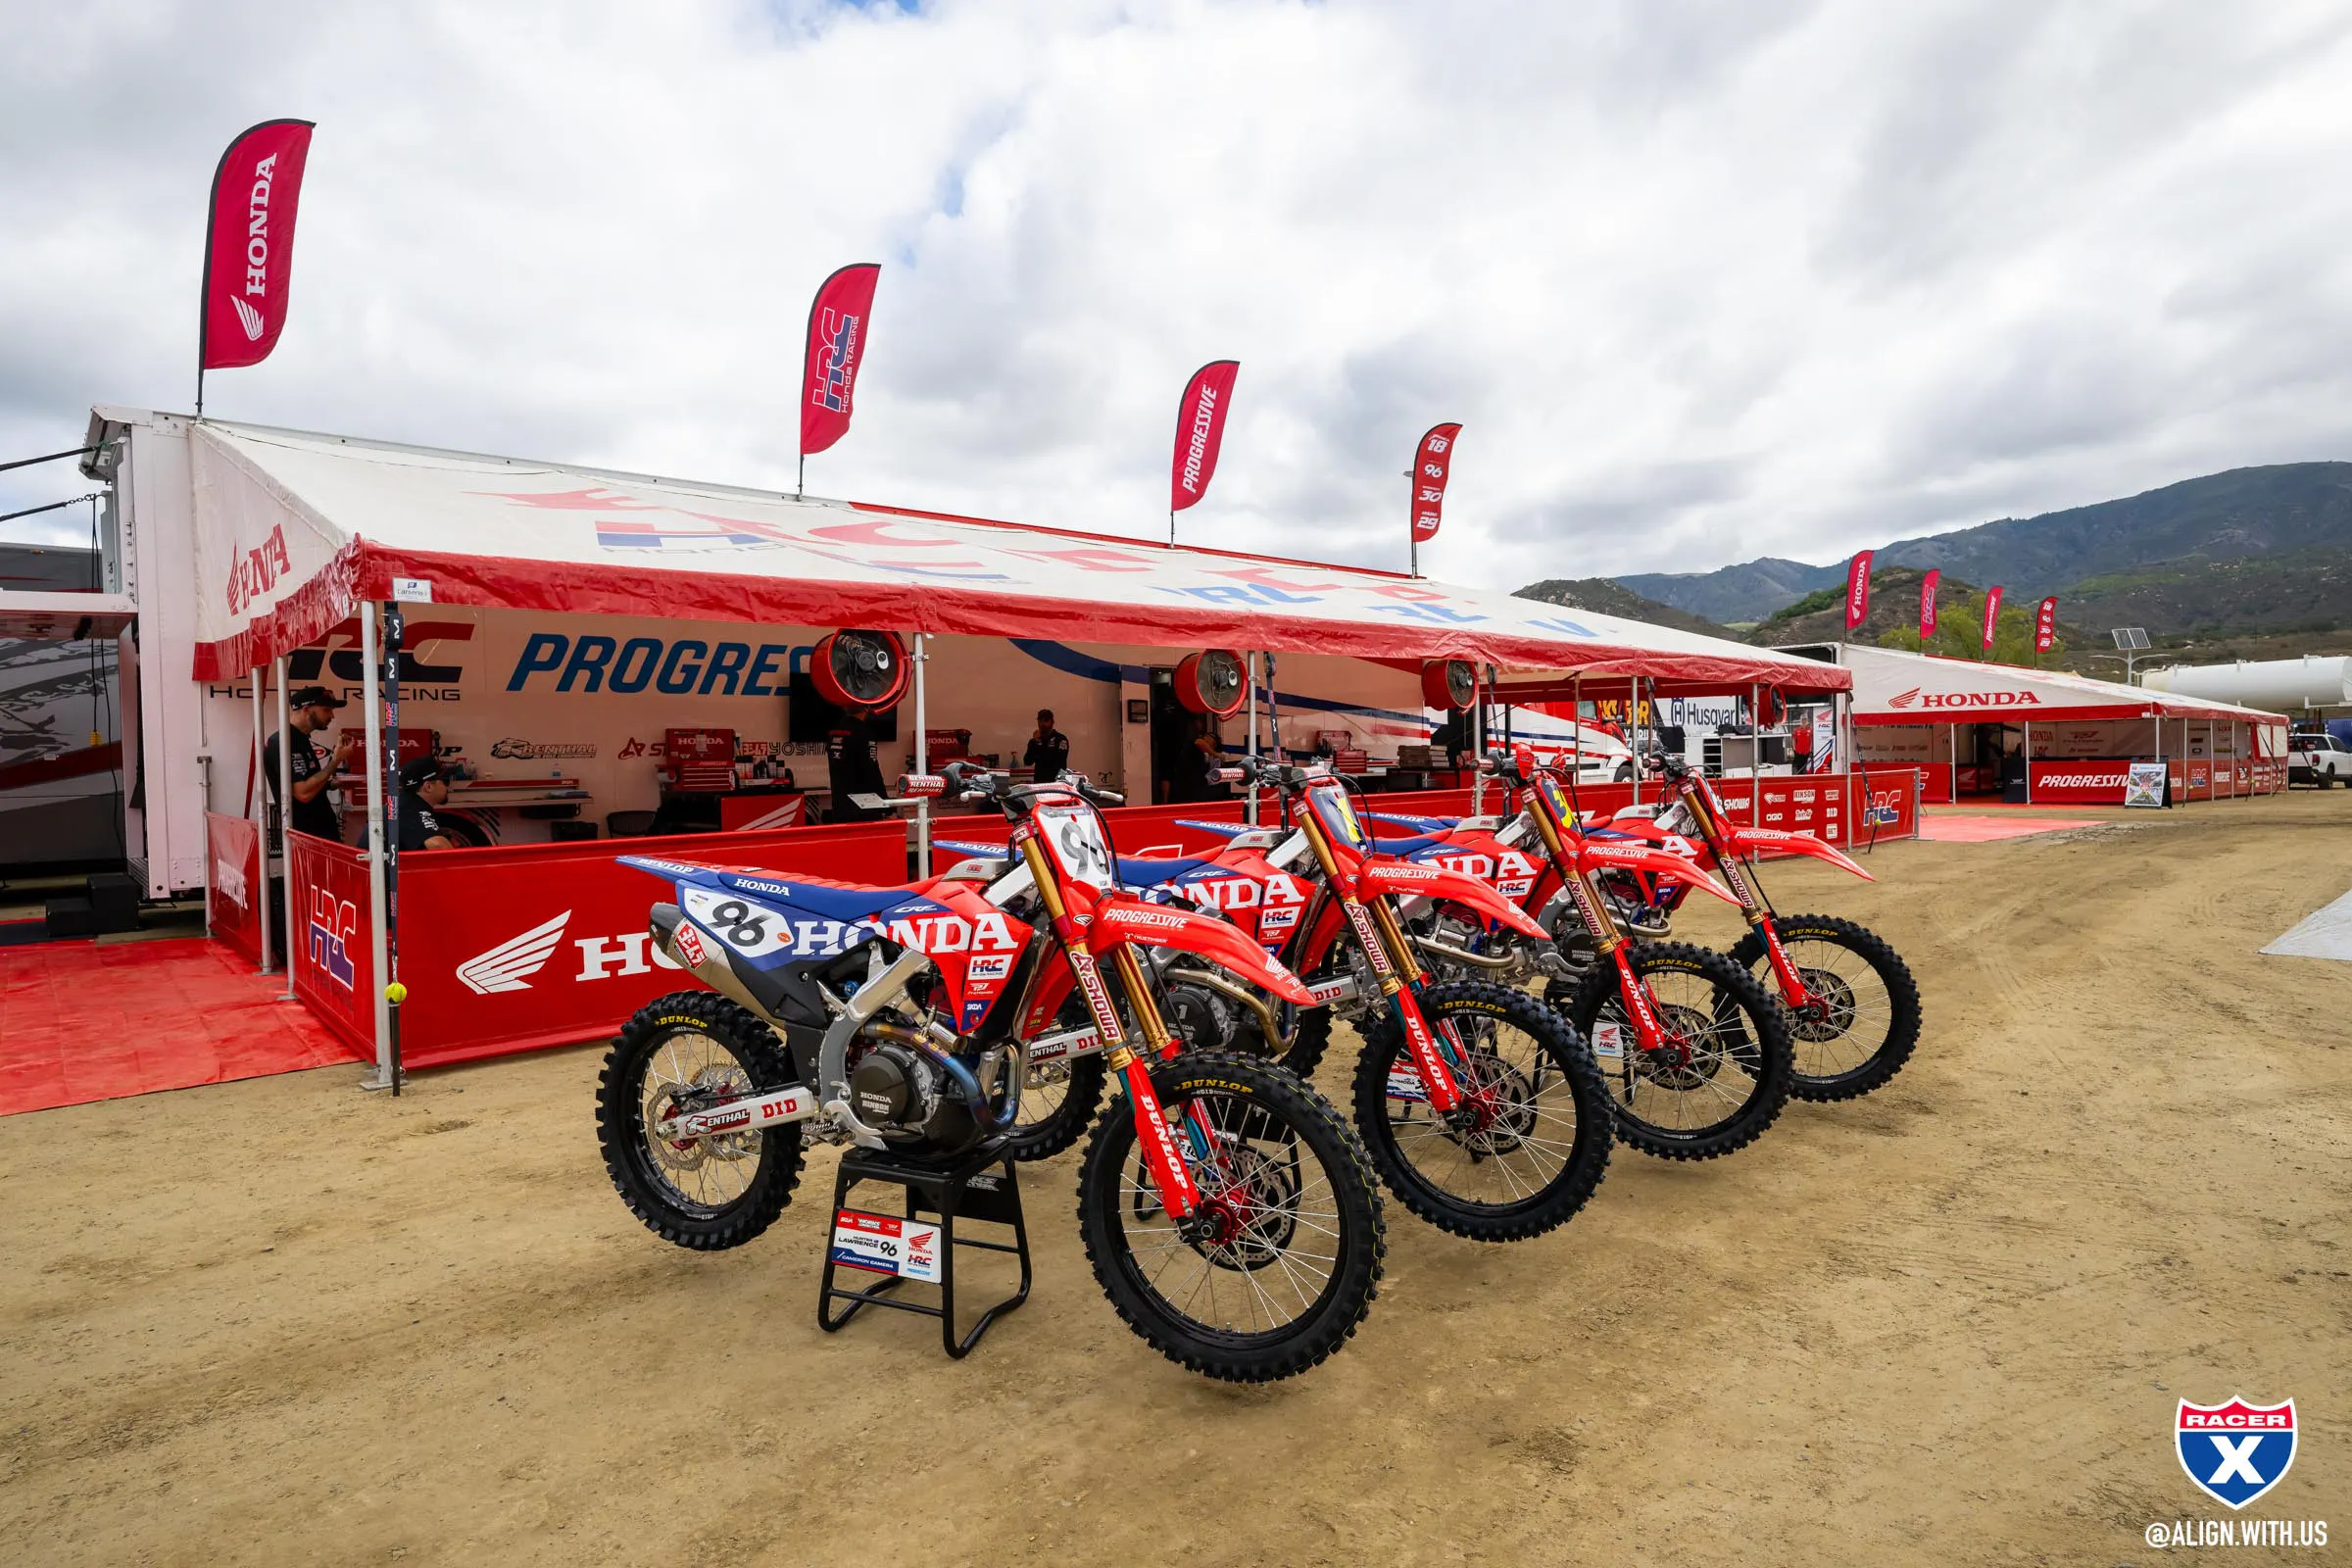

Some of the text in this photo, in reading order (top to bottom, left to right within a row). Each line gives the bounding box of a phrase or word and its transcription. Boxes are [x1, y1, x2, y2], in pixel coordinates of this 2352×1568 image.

[246, 153, 277, 297] HONDA
[812, 307, 854, 413] HRC
[842, 316, 859, 414] Honda RACING
[1182, 383, 1217, 494] PROGRESSIVE
[1427, 439, 1448, 454] 18
[1424, 464, 1443, 478] 96
[1418, 490, 1443, 503] 30
[1416, 516, 1439, 530] 29
[1854, 561, 1866, 606] HONDA
[1921, 690, 2042, 709] HONDA
[1724, 798, 1750, 810] SHOWA
[1734, 830, 1791, 840] PROGRESSIVE
[954, 842, 1007, 855] DUNLOP
[1587, 846, 1650, 859] PROGRESSIVE
[637, 858, 695, 874] DUNLOP
[1368, 866, 1441, 880] PROGRESSIVE
[734, 878, 790, 897] HONDA
[1499, 882, 1528, 893] HRC
[1730, 870, 1754, 909] SHOWA
[893, 905, 938, 913] CRF
[1264, 910, 1294, 923] HRC
[1576, 892, 1602, 938] SHOWA
[708, 899, 772, 949] 96
[1103, 907, 1190, 929] PROGRESSIVE
[310, 884, 357, 993] HRC
[791, 912, 1019, 956] HONDA
[1787, 927, 1838, 937] DUNLOP
[1355, 919, 1389, 973] SHOWA
[972, 958, 1004, 972] HRC
[1646, 958, 1702, 970] DUNLOP
[1768, 931, 1800, 985] DUNLOP
[1084, 975, 1119, 1041] SHOWA
[1444, 1000, 1507, 1014] DUNLOP
[1621, 968, 1656, 1032] DUNLOP
[660, 1015, 708, 1028] DUNLOP
[1407, 1014, 1449, 1093] DUNLOP
[1180, 1078, 1253, 1094] DUNLOP
[859, 1091, 893, 1104] HONDA
[686, 1108, 752, 1136] RENTHAL
[1141, 1095, 1189, 1190] DUNLOP
[838, 1237, 898, 1256] LAWRENCE 96
[908, 1246, 933, 1255] HONDA
[841, 1254, 894, 1269] CAMERON CAMERA
[907, 1254, 933, 1266] HRC
